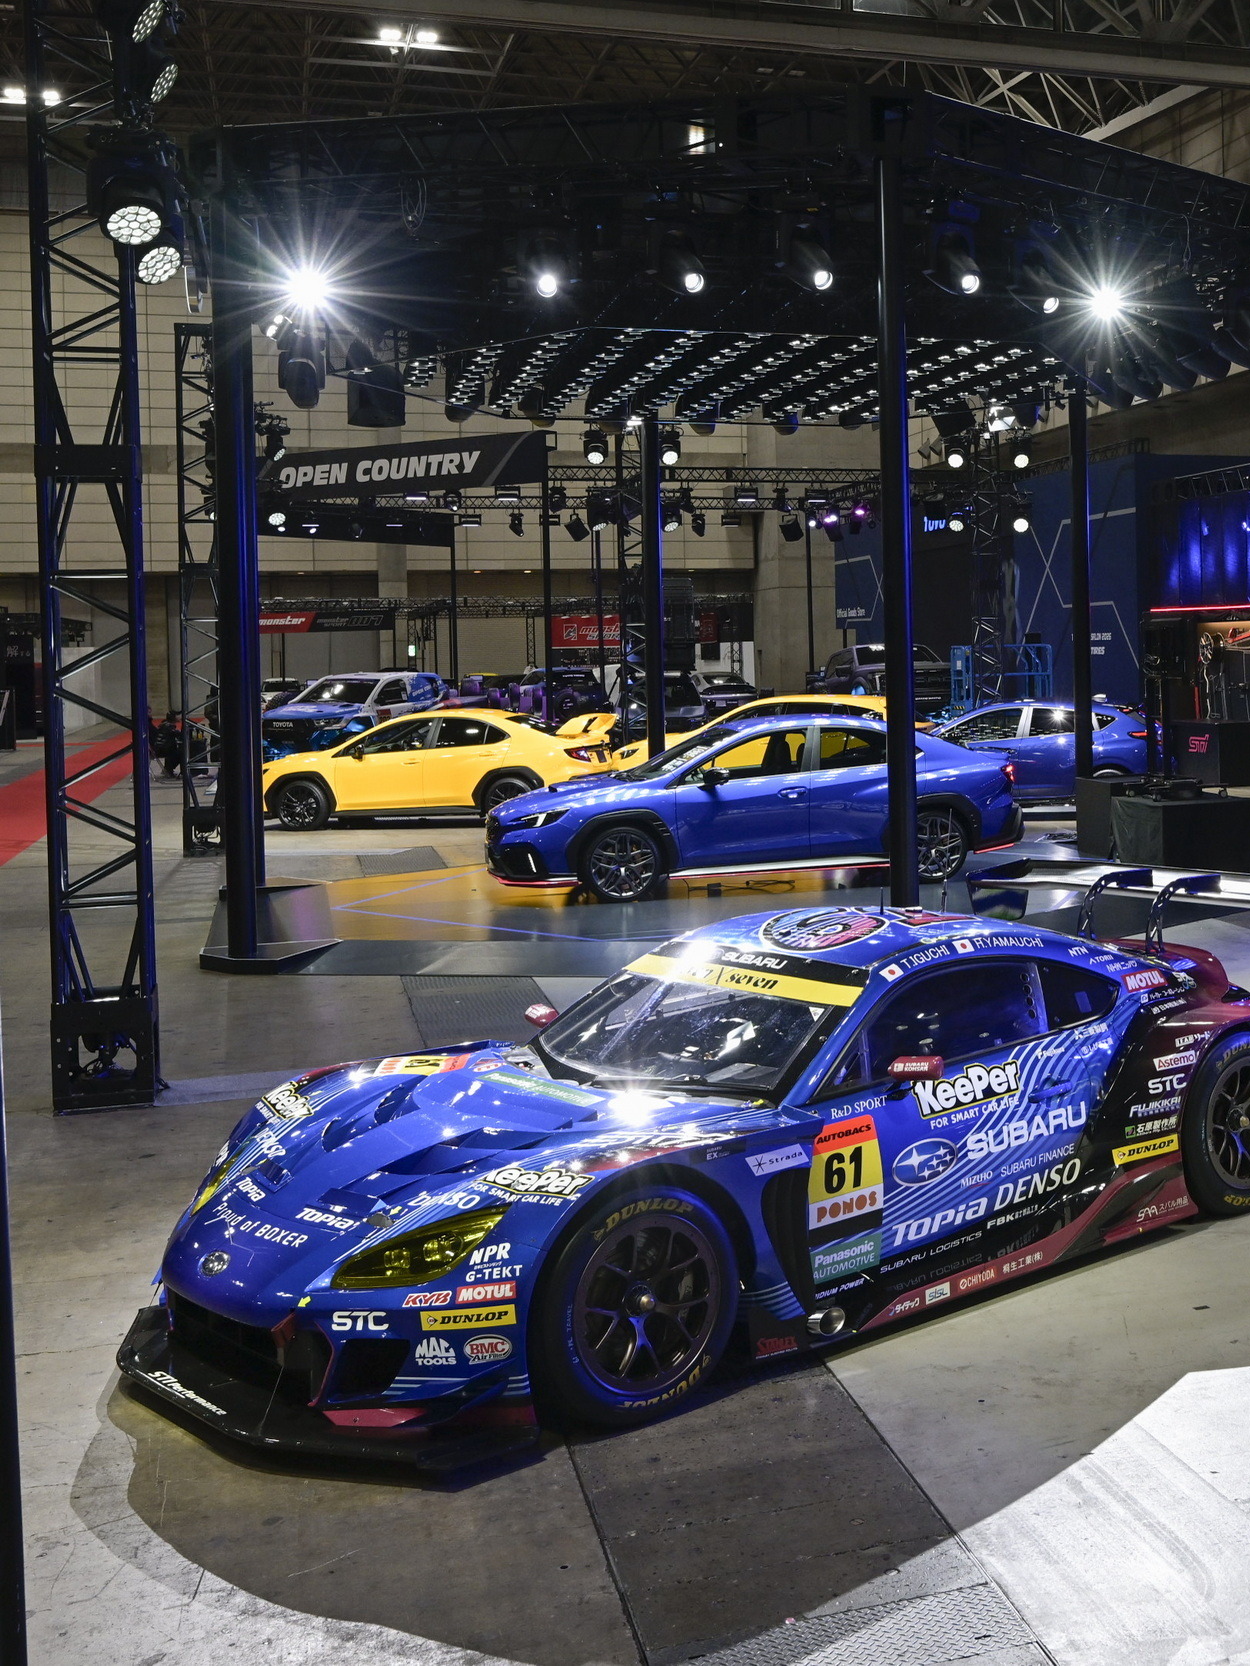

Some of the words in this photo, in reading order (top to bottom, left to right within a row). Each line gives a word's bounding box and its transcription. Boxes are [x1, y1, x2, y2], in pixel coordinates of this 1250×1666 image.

[279, 463, 348, 489] OPEN
[355, 451, 481, 483] COUNTRY
[259, 616, 306, 626] monster
[722, 951, 788, 969] SUBARU
[1068, 946, 1089, 958] NTN
[725, 972, 779, 989] seven
[1125, 971, 1165, 990] MOTUL
[1158, 1054, 1195, 1069] Astemo
[913, 1061, 1019, 1116] KeePer
[1147, 1073, 1187, 1094] STC
[831, 1104, 852, 1119] R&D
[854, 1095, 887, 1114] SPORT
[930, 1118, 949, 1130] FOR
[951, 1107, 979, 1124] SMART
[982, 1102, 1000, 1114] CAR
[1001, 1096, 1020, 1110] LIFE
[1129, 1096, 1182, 1118] FUJIKIKAI
[816, 1124, 872, 1145] AUTOBACS
[966, 1100, 1087, 1160] SUBARU
[1128, 1139, 1174, 1157] DUNLOP
[769, 1151, 803, 1165] Strada
[1000, 1158, 1036, 1177] SUBARU
[1038, 1143, 1075, 1165] FINANCE
[824, 1146, 863, 1195] 61
[960, 1170, 993, 1189] MIZUHO
[993, 1158, 1082, 1211] DENSO
[488, 1187, 521, 1203] SMART
[521, 1194, 538, 1204] CAR
[539, 1196, 563, 1206] LIFE
[606, 1197, 694, 1232] DUNLOP
[817, 1190, 878, 1223] PONOS
[212, 1203, 246, 1226] Proud
[240, 1219, 257, 1233] of
[255, 1222, 309, 1249] BOXER
[987, 1212, 1015, 1229] FBK
[469, 1242, 511, 1265] NPR
[814, 1240, 874, 1267] Panasonic
[880, 1252, 927, 1274] SUBARU
[930, 1230, 982, 1256] LOGISTICS
[466, 1265, 523, 1282] G-TEKT
[813, 1252, 875, 1279] AUTOMOTIVE
[839, 1278, 865, 1292] POWER
[967, 1269, 995, 1287] CHIYODA
[402, 1291, 453, 1307] KYB
[458, 1284, 514, 1302] MOTUL
[894, 1298, 920, 1314] ダイテック
[331, 1311, 389, 1331] STC
[440, 1311, 509, 1325] DUNLOP
[415, 1337, 456, 1358] MAC
[469, 1341, 506, 1355] BMC
[416, 1357, 457, 1366] TOOLS
[472, 1354, 488, 1363] Air
